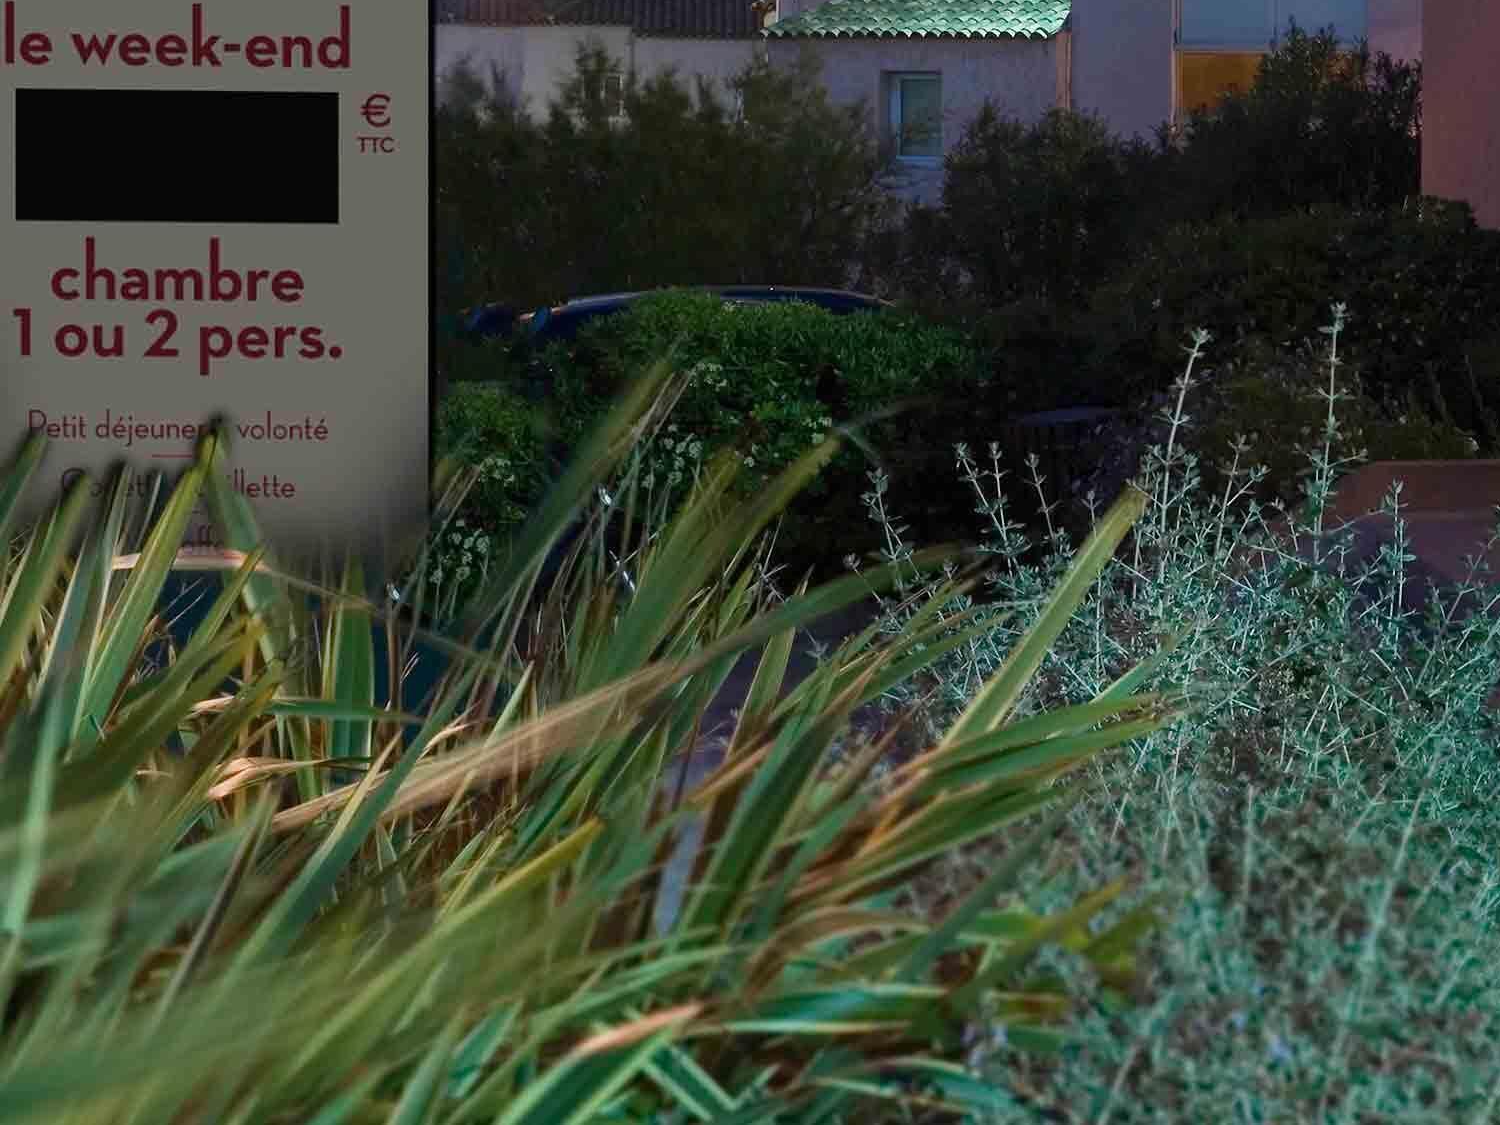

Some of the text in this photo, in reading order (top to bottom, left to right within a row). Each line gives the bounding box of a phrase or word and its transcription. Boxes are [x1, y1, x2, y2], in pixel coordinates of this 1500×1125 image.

[5, 1, 351, 68] le week-end
[360, 94, 391, 128] €
[357, 136, 394, 153] TTC
[51, 236, 304, 303] chambre
[13, 308, 342, 376] 1 ou 2 pers.
[28, 410, 88, 439] Petit
[238, 411, 329, 441] volonté
